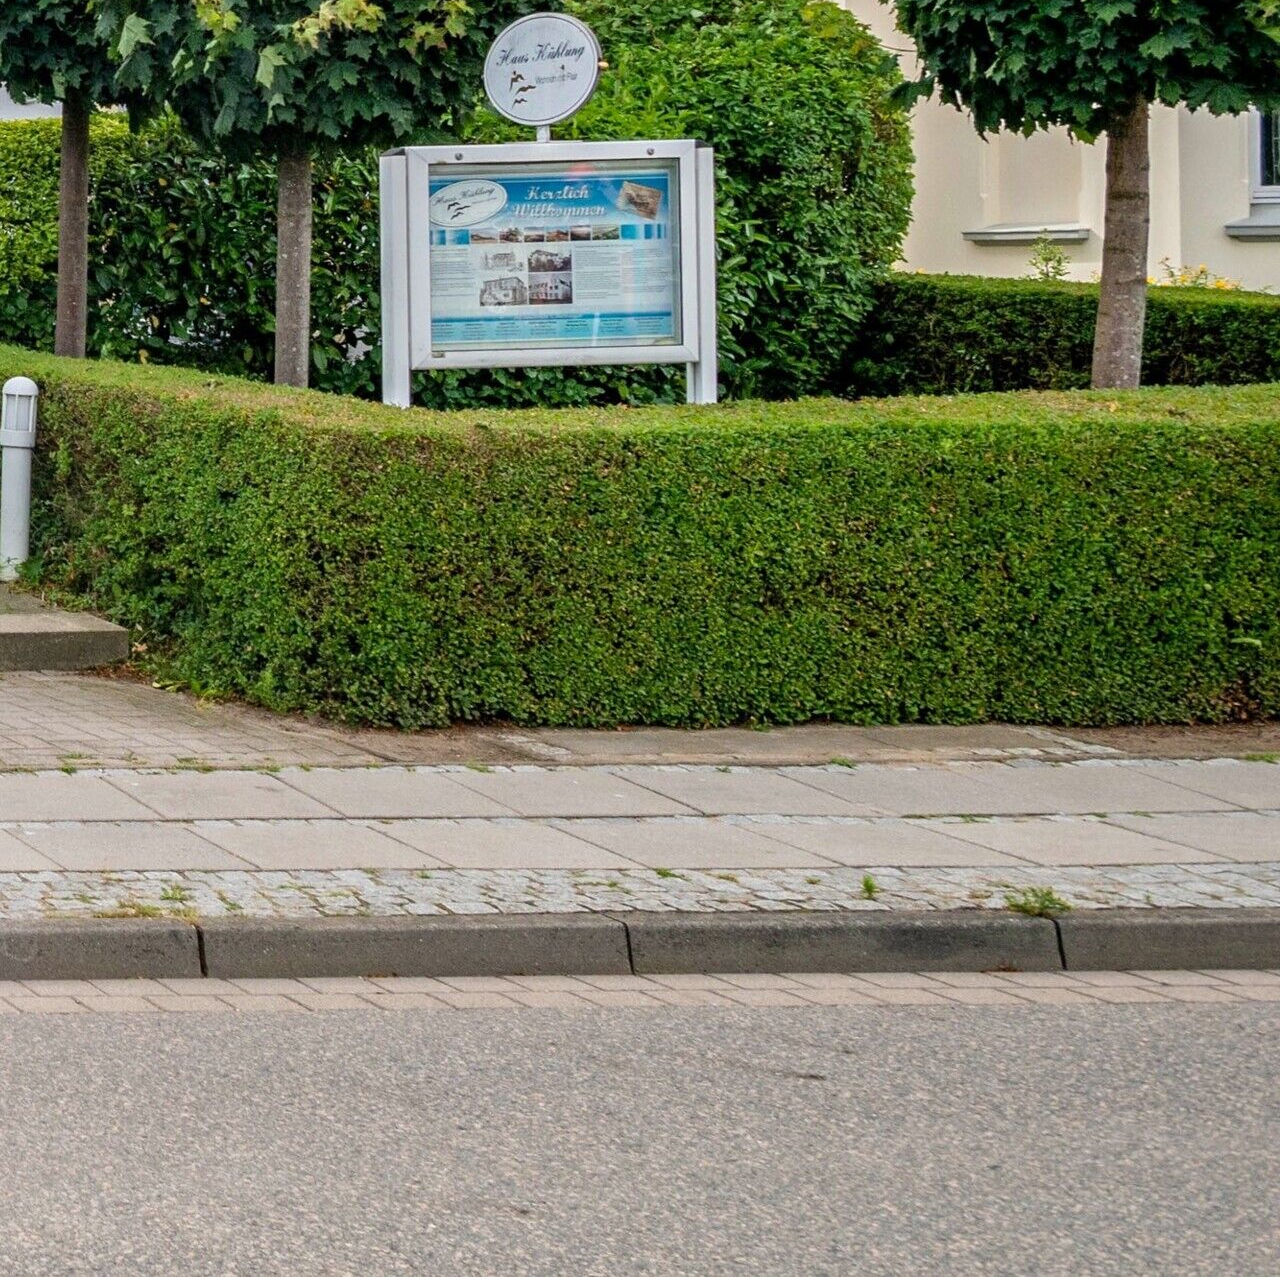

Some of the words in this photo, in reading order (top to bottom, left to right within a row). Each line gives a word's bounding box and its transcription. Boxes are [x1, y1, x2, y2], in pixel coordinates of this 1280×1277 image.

[495, 48, 529, 66] Haus
[532, 38, 585, 62] Kühlung
[525, 185, 589, 201] Herzlich
